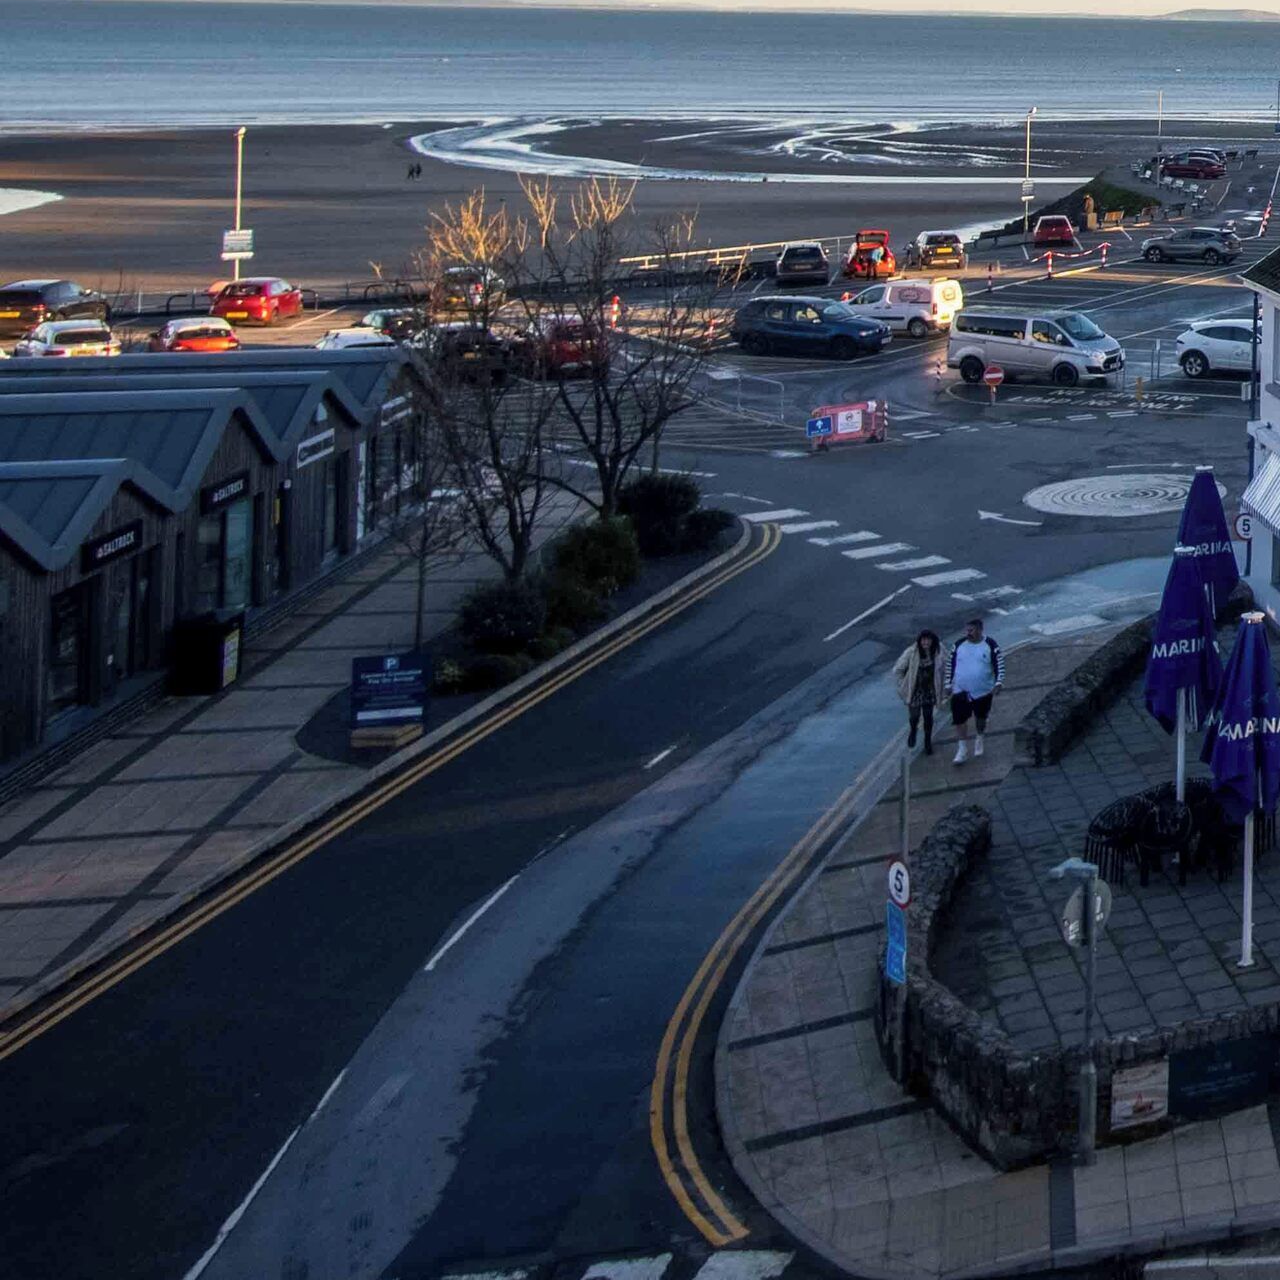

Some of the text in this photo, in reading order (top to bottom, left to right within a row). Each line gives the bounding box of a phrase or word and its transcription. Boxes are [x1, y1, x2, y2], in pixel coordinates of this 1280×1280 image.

[1241, 518, 1251, 533] 5
[1176, 540, 1232, 558] ARINA
[893, 869, 905, 893] 5
